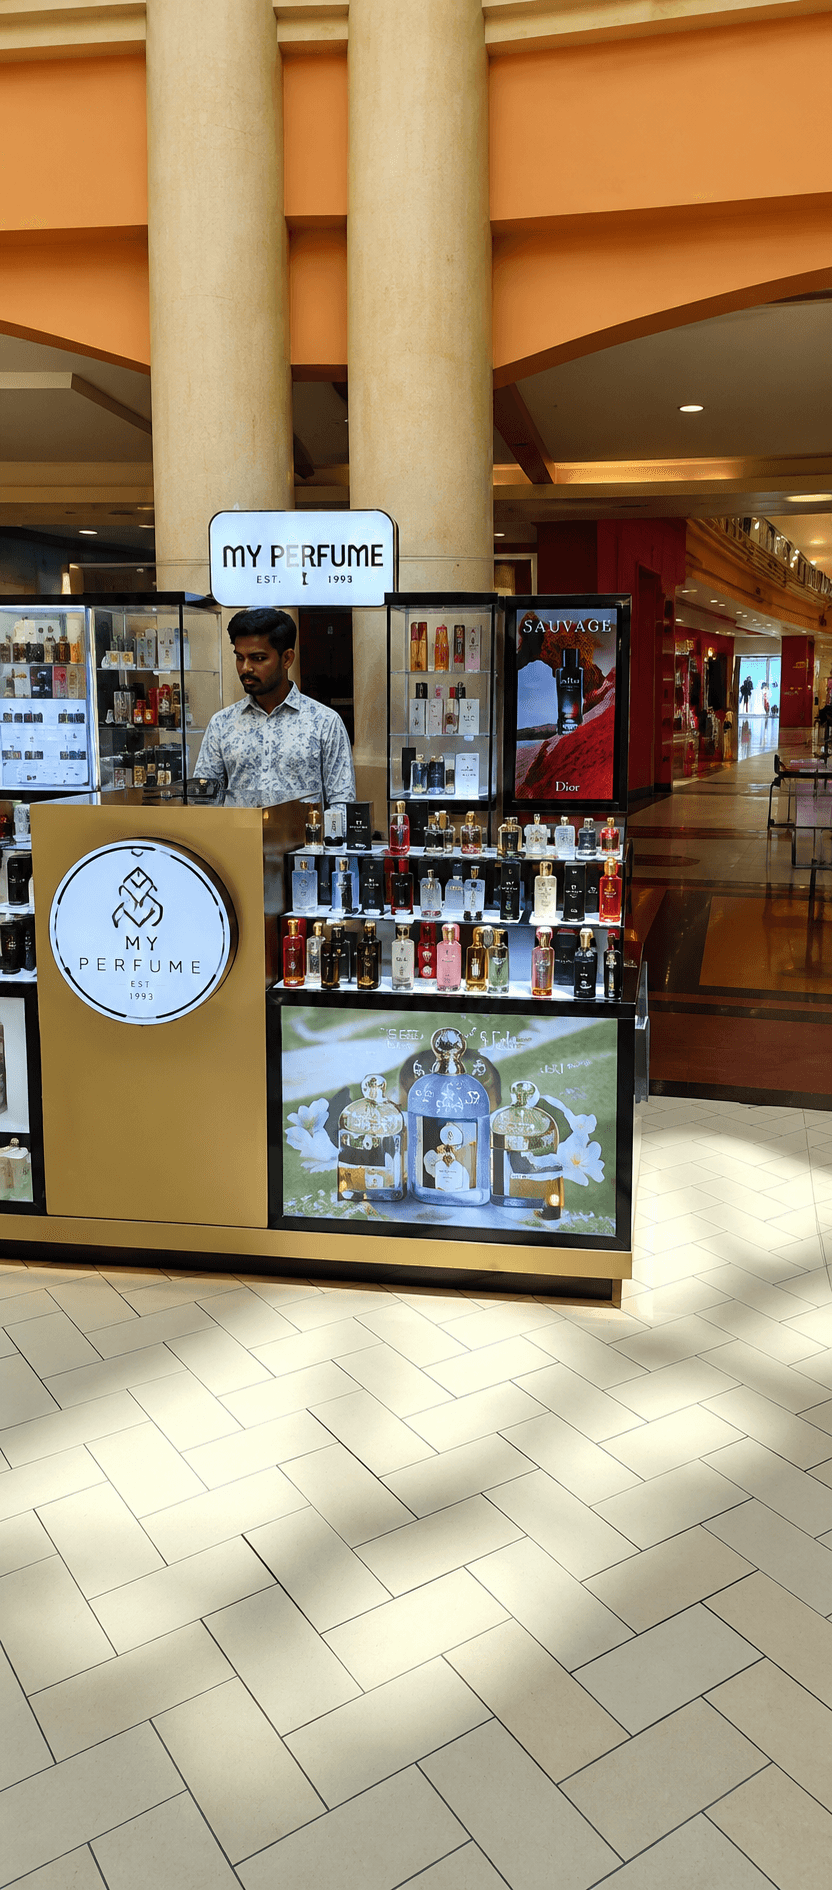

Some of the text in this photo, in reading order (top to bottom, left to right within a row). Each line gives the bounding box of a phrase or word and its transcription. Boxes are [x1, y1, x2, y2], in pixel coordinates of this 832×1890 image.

[223, 544, 383, 567] MY PERFUME
[256, 575, 353, 583] EST. 1993
[523, 619, 612, 633] SAUVAGE
[555, 781, 580, 791] Dior
[125, 935, 158, 951] MY
[79, 957, 201, 974] PERFUME
[130, 980, 150, 988] EST
[129, 992, 154, 1001] 1993
